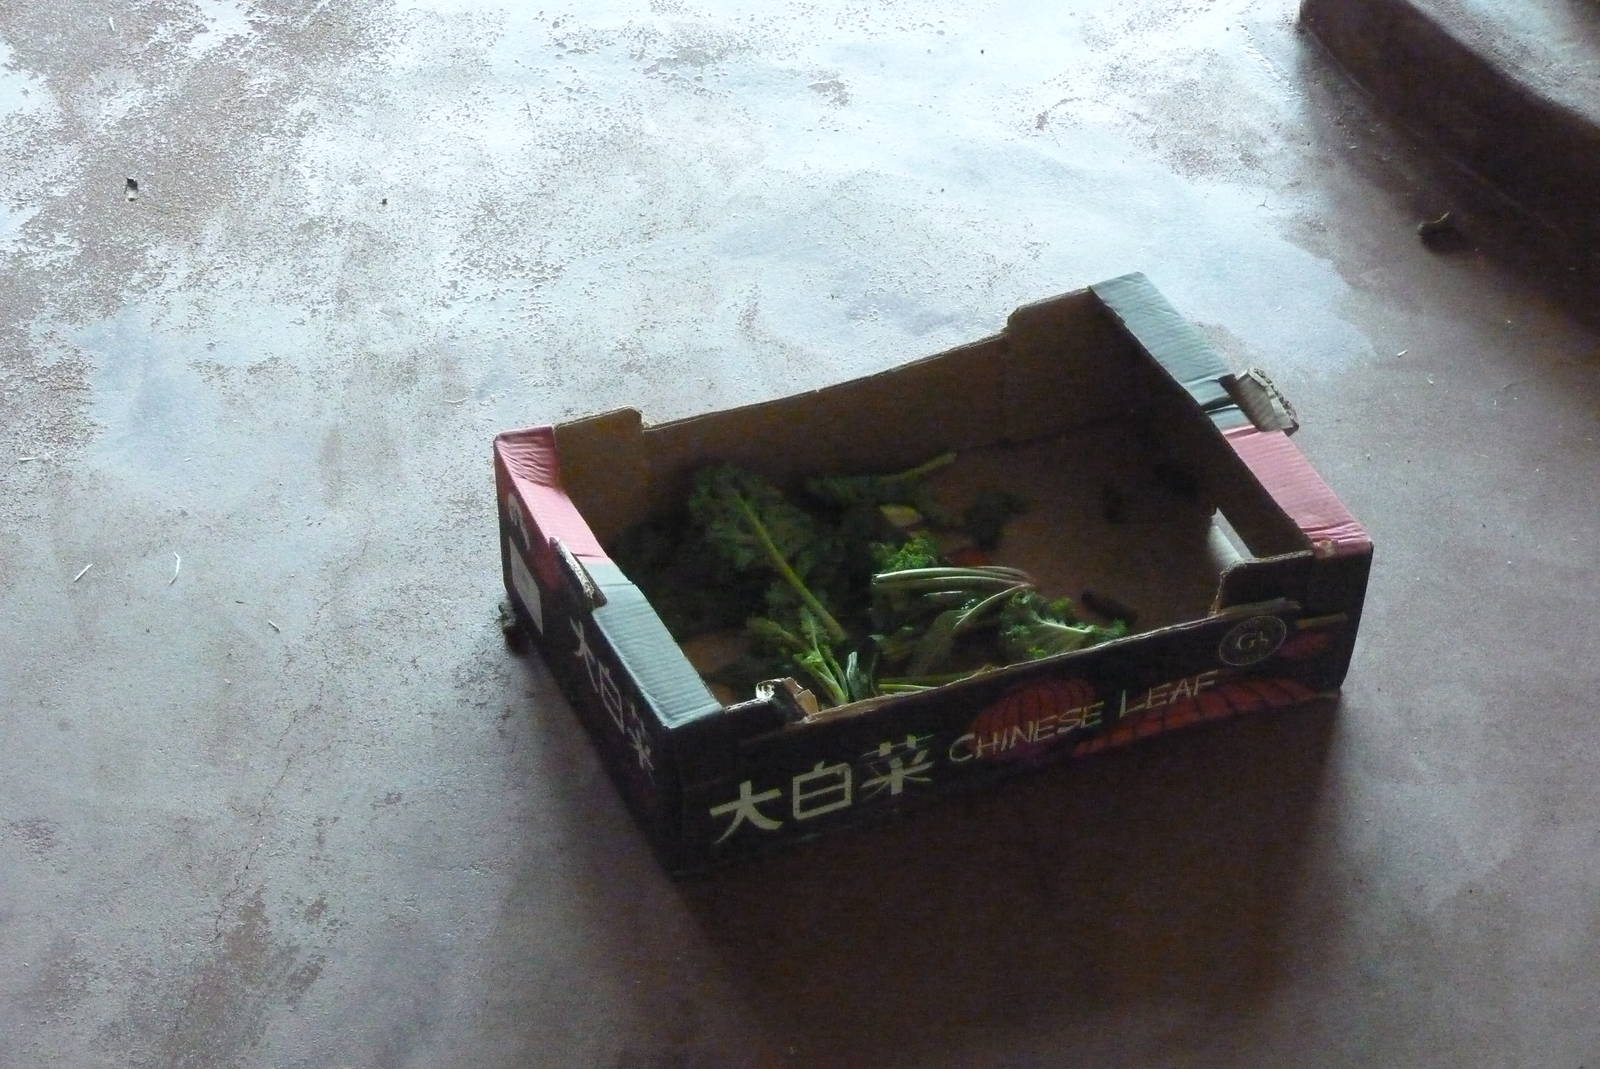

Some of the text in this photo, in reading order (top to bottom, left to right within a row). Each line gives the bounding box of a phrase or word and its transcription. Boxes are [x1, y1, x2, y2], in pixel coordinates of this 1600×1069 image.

[949, 670, 1218, 762] CHINESE LEAF
[709, 734, 935, 845] 大白菜
